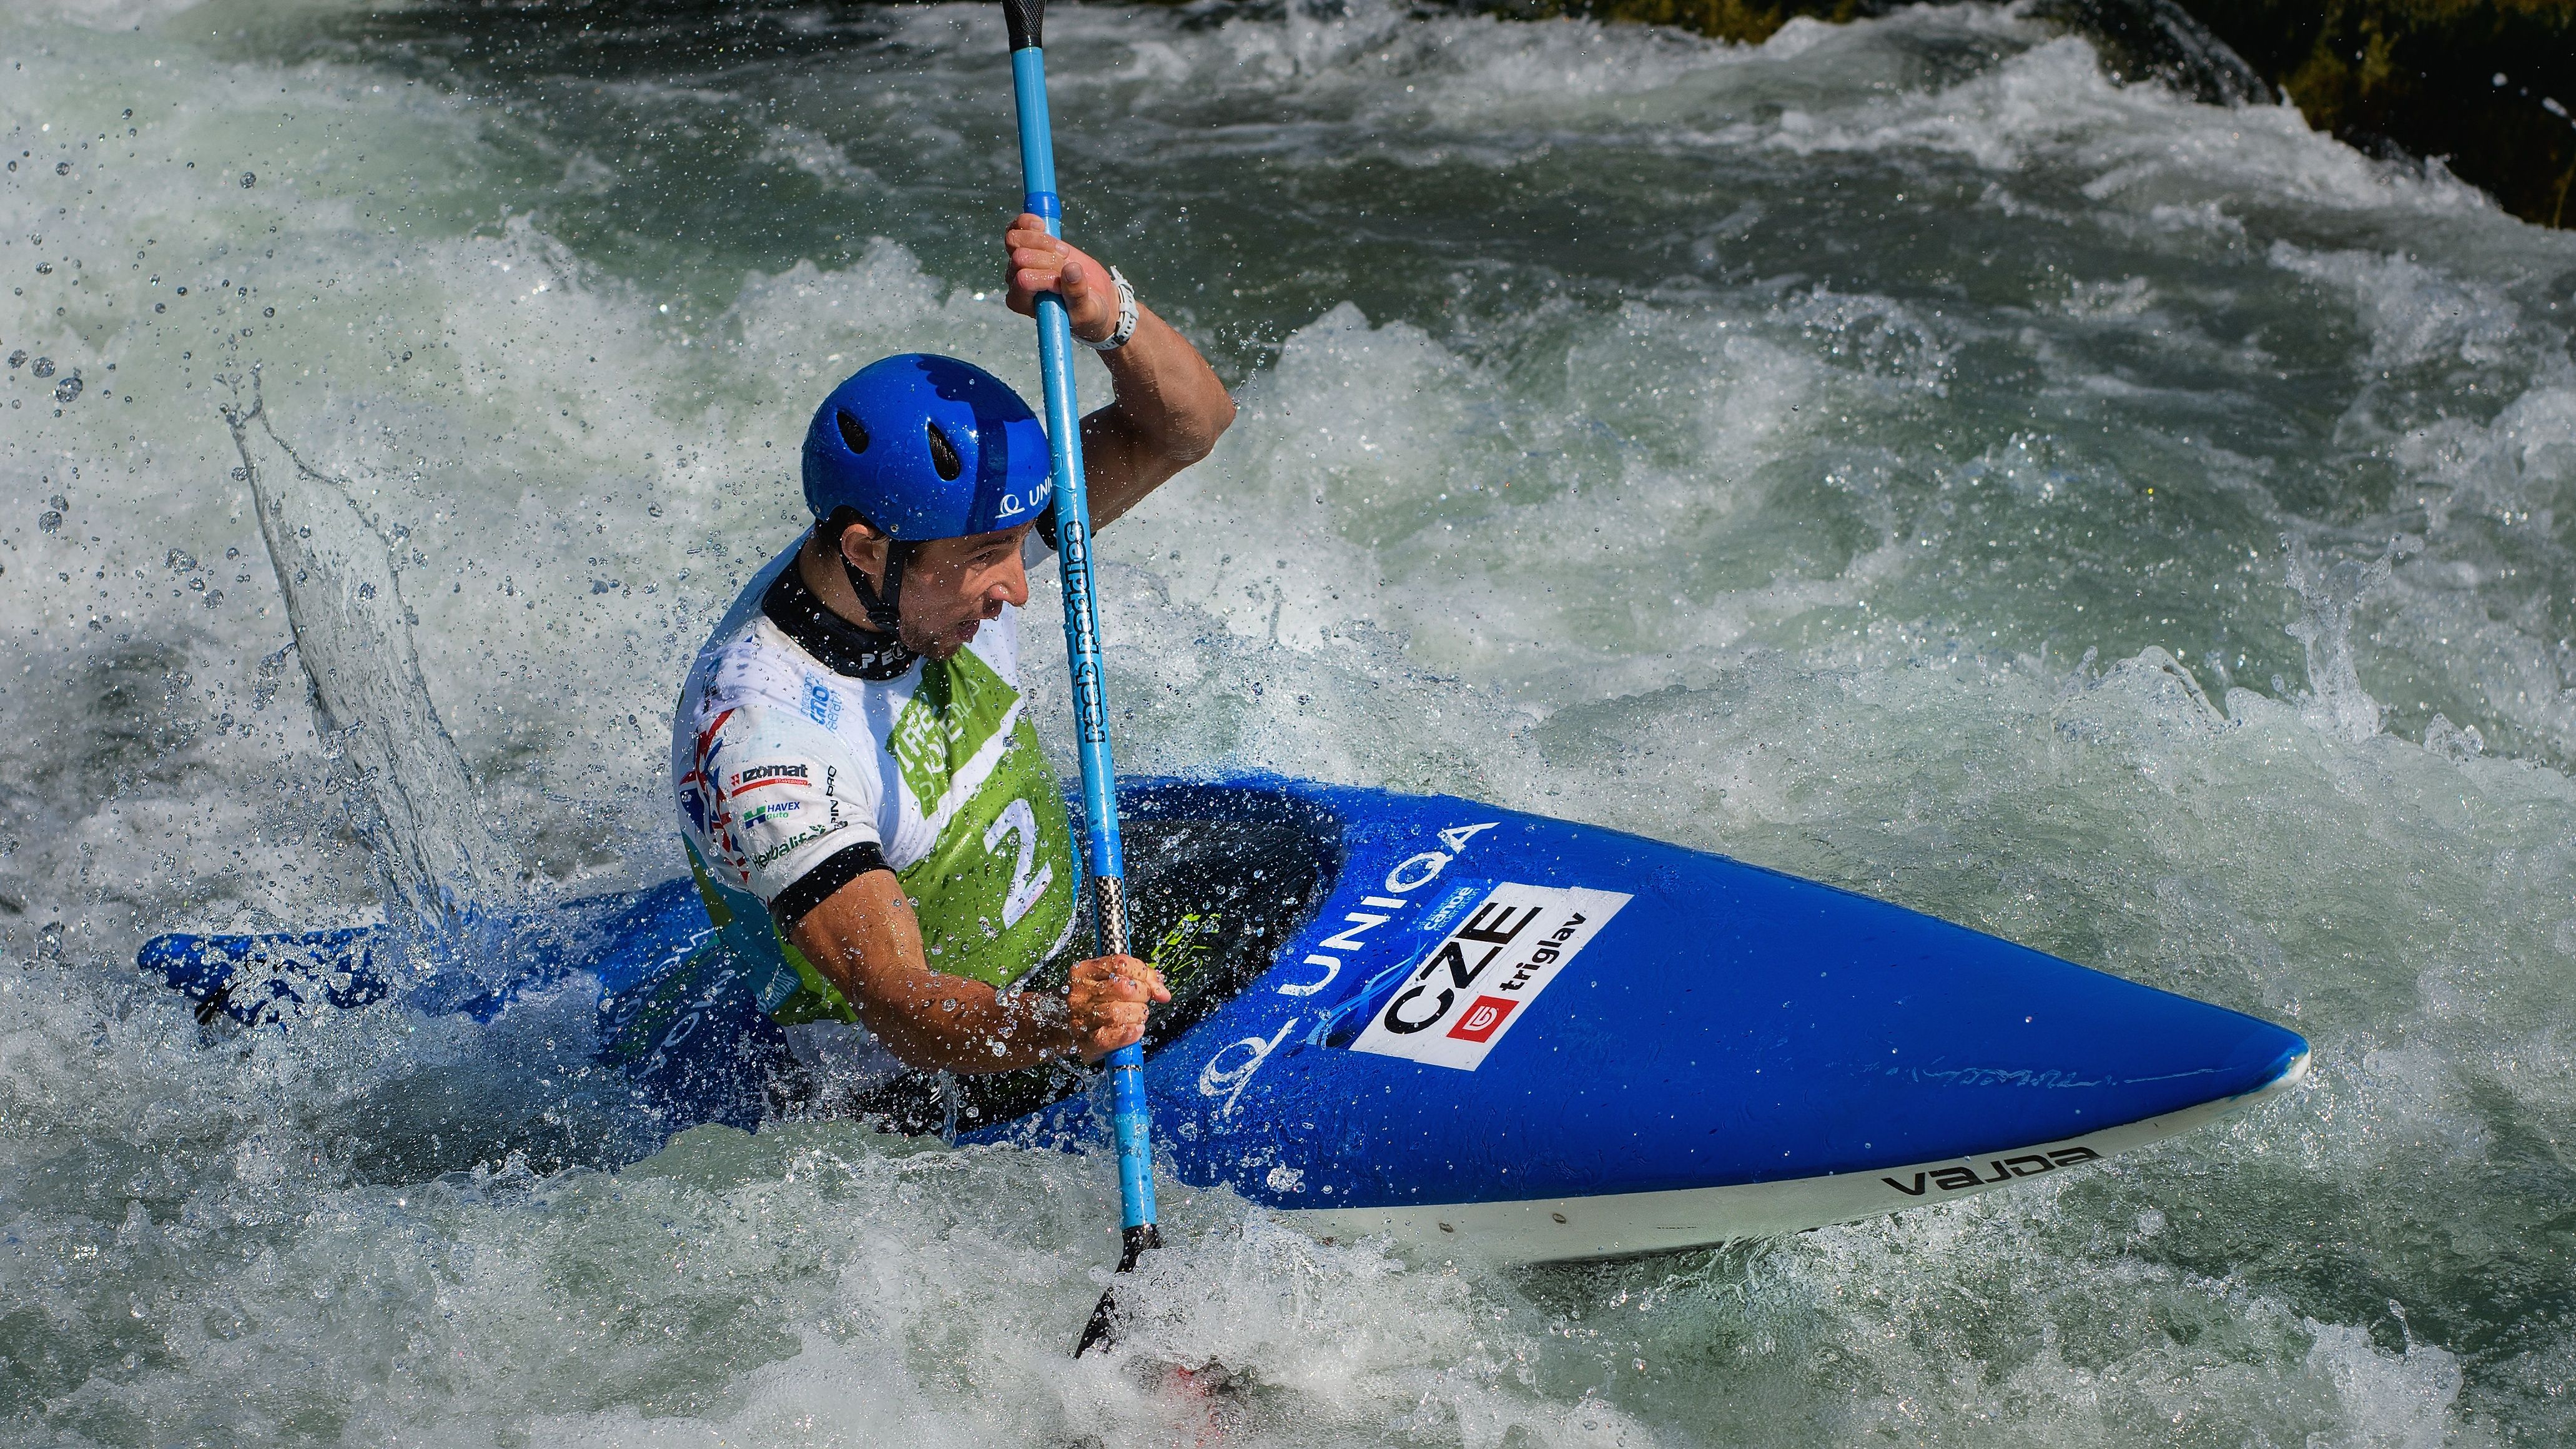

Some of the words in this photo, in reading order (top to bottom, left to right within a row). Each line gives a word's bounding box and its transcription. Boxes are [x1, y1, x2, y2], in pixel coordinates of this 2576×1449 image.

[1029, 470, 1053, 506] UNI
[1064, 520, 1100, 655] paddles
[767, 801, 801, 813] HAVEX
[825, 764, 837, 797] PRO
[766, 812, 789, 821] auto
[983, 798, 1054, 930] 2
[1277, 821, 1501, 996] UNIQA
[1423, 887, 1474, 931] canoe
[1433, 888, 1482, 932] federation
[1383, 902, 1543, 1035] CZE
[1499, 912, 1587, 991] triglav
[634, 969, 736, 1082] NIQA
